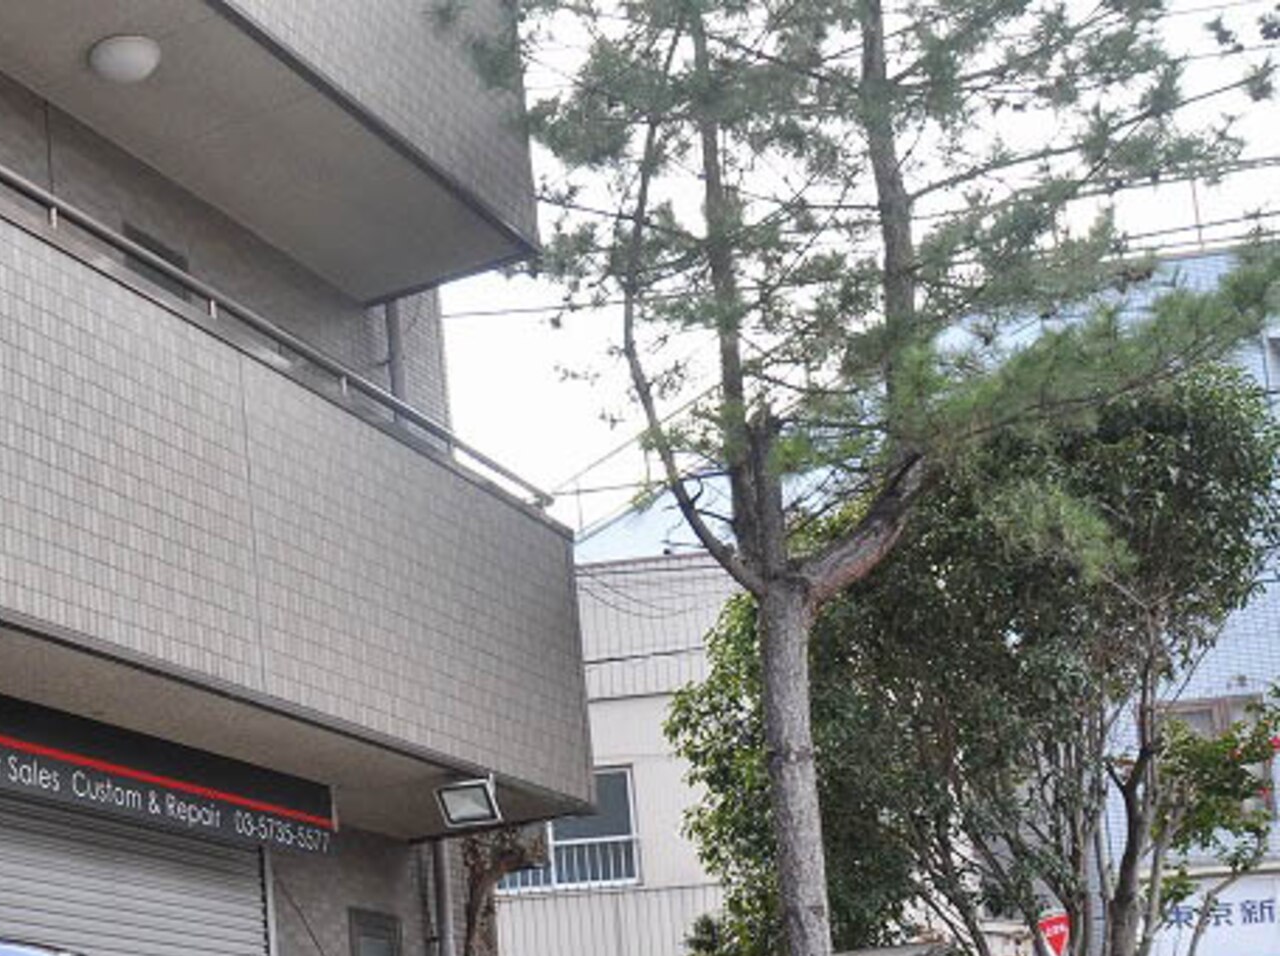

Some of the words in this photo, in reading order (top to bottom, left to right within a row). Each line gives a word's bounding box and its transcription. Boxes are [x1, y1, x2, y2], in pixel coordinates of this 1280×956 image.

[7, 754, 61, 792] Sales
[72, 770, 142, 810] Custom
[148, 789, 161, 815] &
[166, 793, 220, 828] Repair
[235, 809, 330, 853] 03-5735-5577
